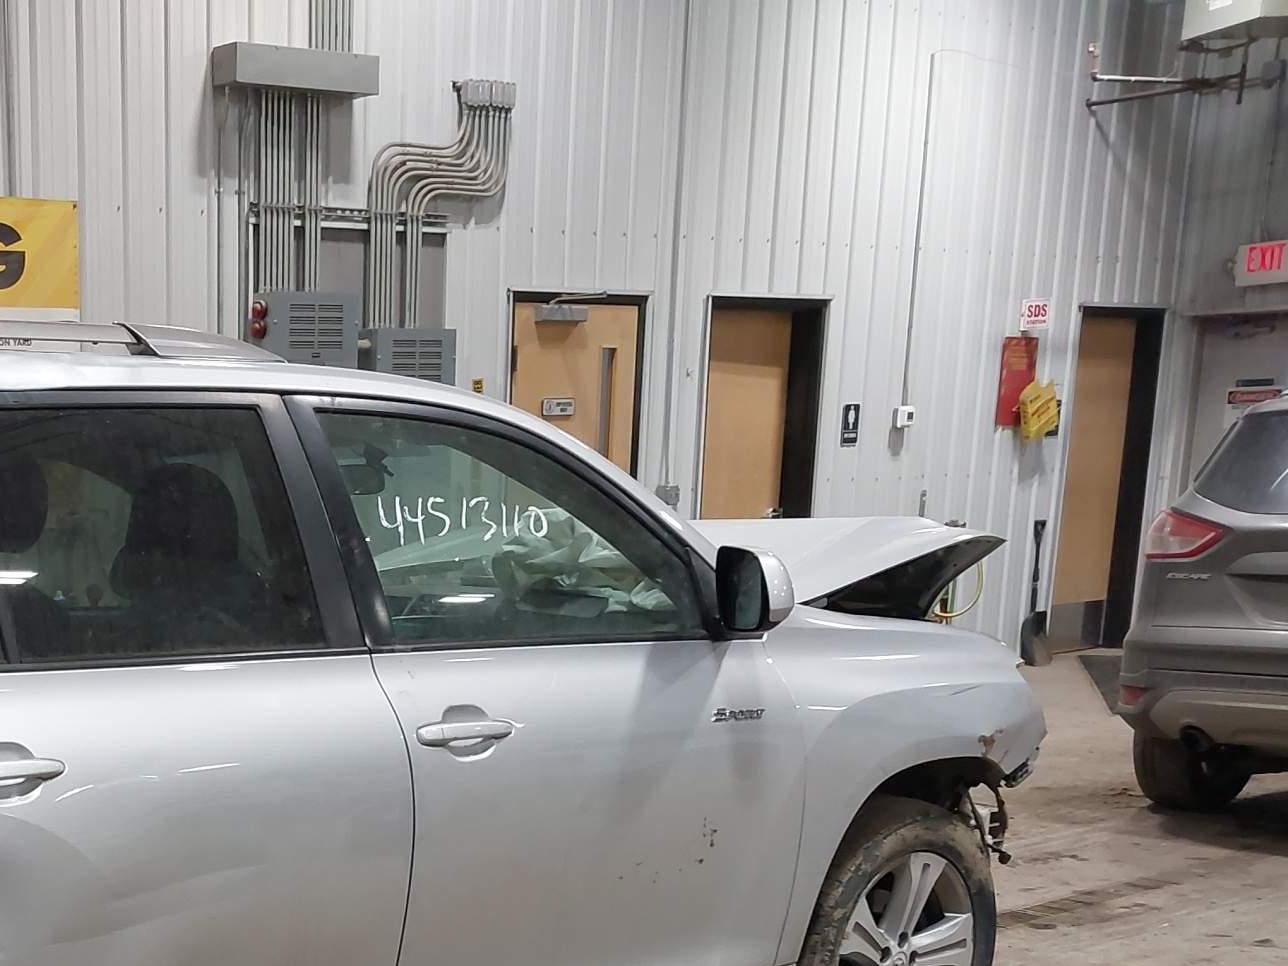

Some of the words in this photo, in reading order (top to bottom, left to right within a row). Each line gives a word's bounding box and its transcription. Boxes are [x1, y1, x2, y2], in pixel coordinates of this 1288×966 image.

[1246, 242, 1287, 273] EXIT
[1026, 303, 1049, 319] SDS
[377, 495, 549, 547] 44513110
